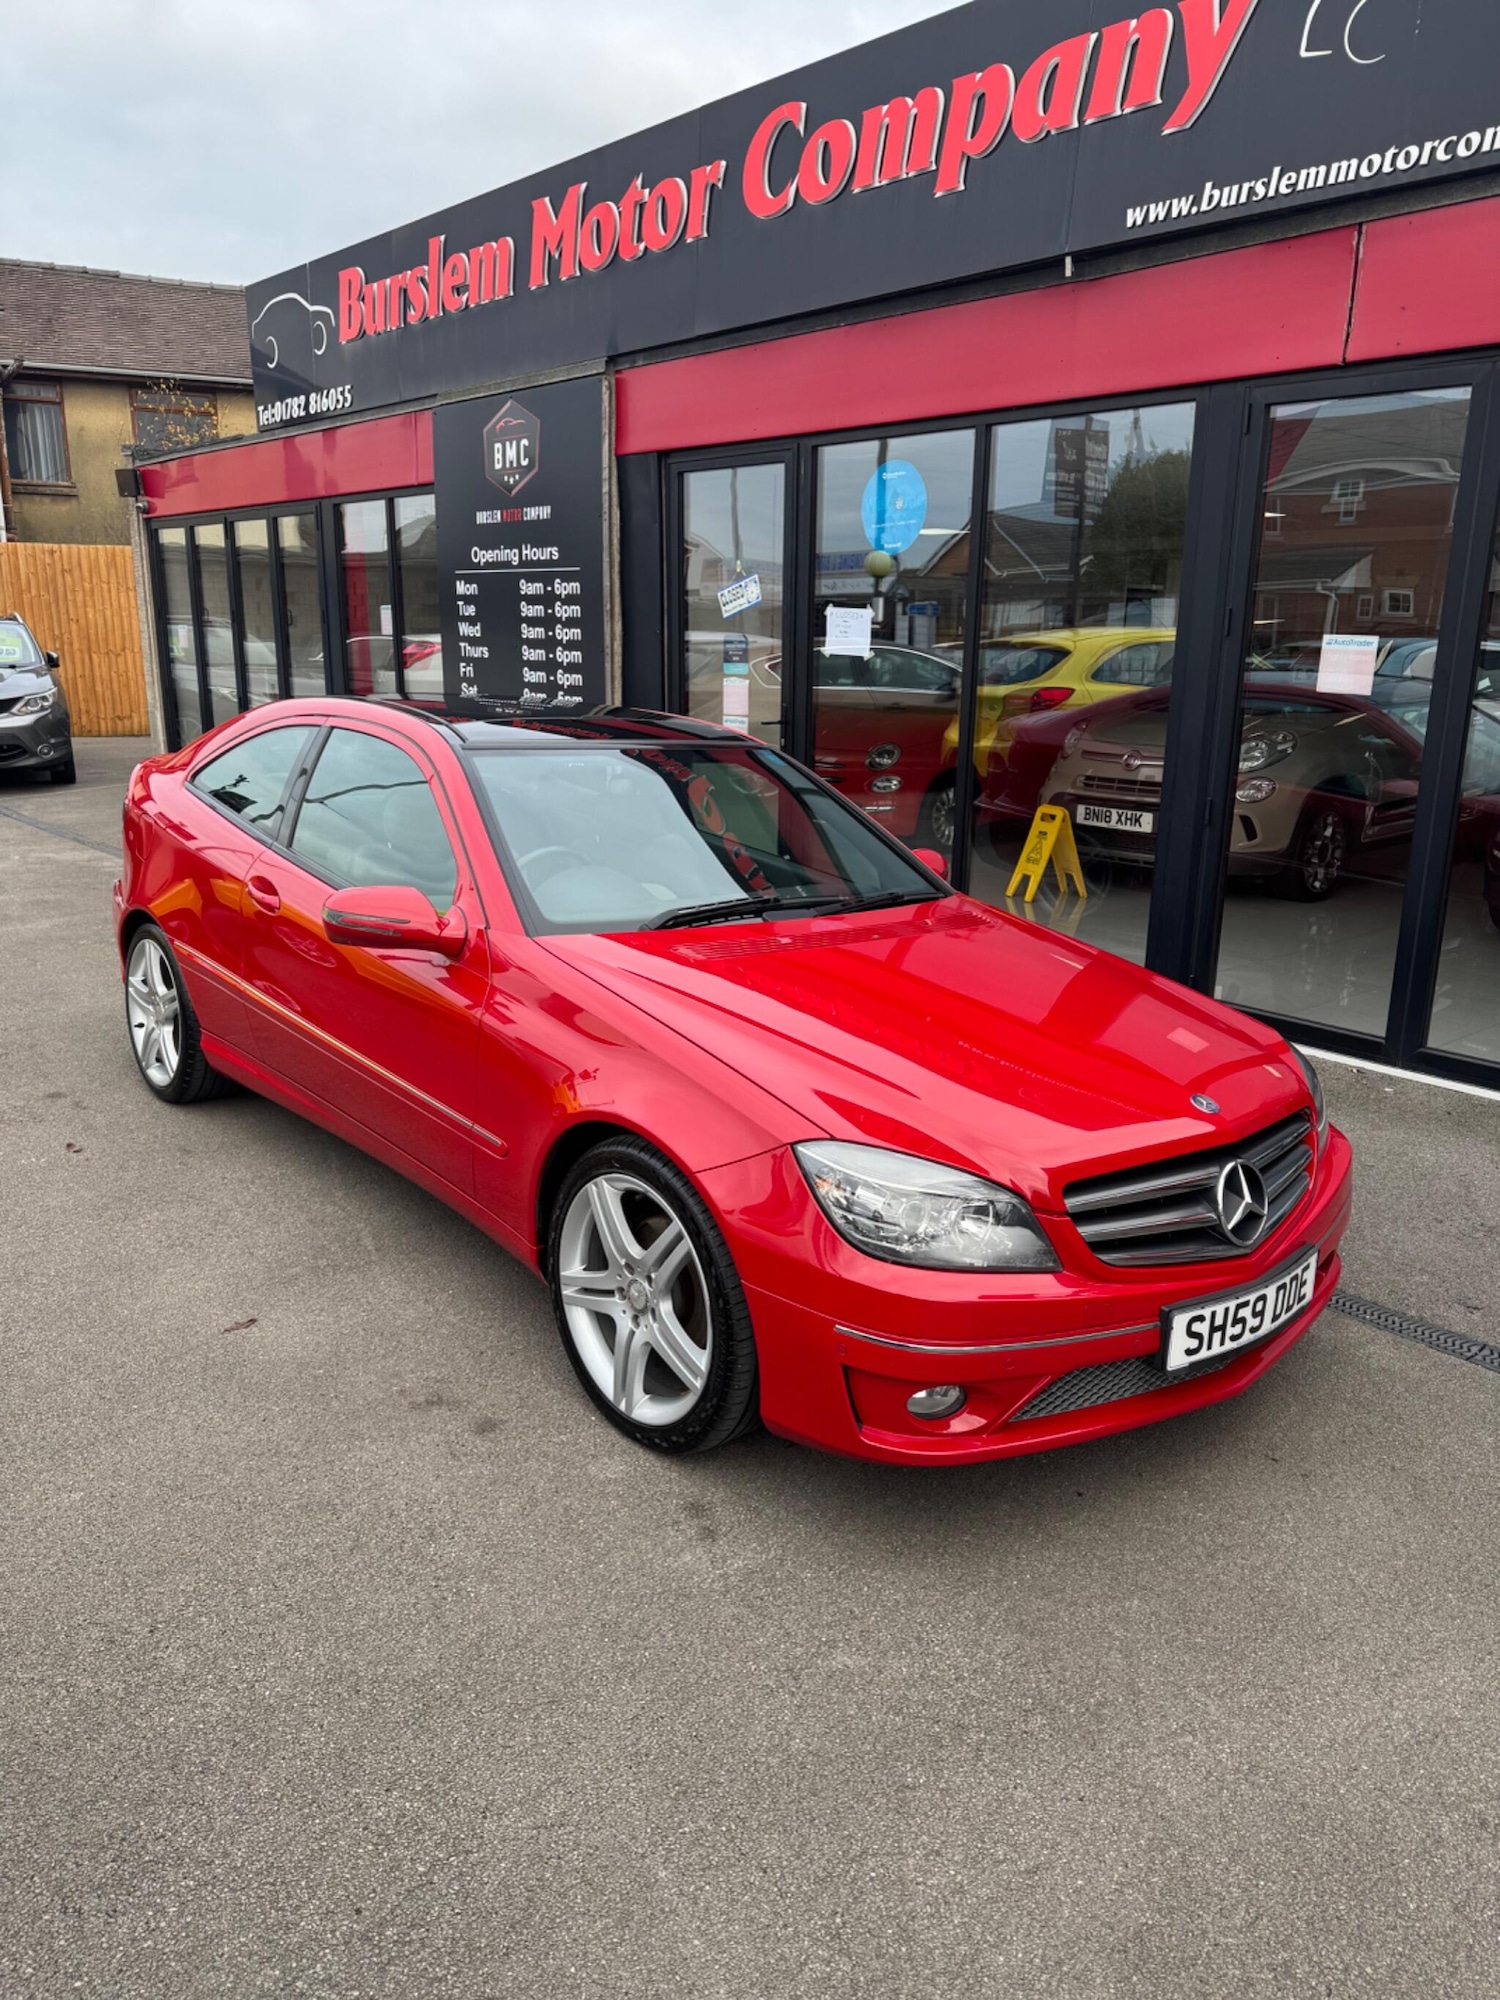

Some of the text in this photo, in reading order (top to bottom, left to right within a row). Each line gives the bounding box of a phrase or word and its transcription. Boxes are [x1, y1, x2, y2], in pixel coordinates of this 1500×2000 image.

[338, 0, 1258, 344] Burslem Motor Company
[257, 384, 352, 426] Tel:01782 816055
[494, 438, 529, 470] BMC
[471, 543, 559, 565] Opening Hours
[456, 580, 478, 595] Mon
[519, 579, 544, 595] 9am
[554, 578, 580, 599] 6pm
[457, 601, 476, 616] Tue
[520, 601, 545, 617] 9am
[555, 601, 581, 621] 6pm
[458, 622, 481, 637] Wed
[521, 623, 545, 638] 9am
[555, 623, 582, 644] 6pm
[459, 642, 489, 658] Thurs
[522, 645, 546, 661] 9am
[556, 646, 582, 666] 6pm
[460, 662, 474, 677] Fri
[522, 666, 547, 683] 9am
[556, 669, 583, 689] 6pm
[461, 682, 478, 695] Sat
[1083, 807, 1143, 828] BN18 XHK
[1184, 1262, 1311, 1357] SH59 DDE
